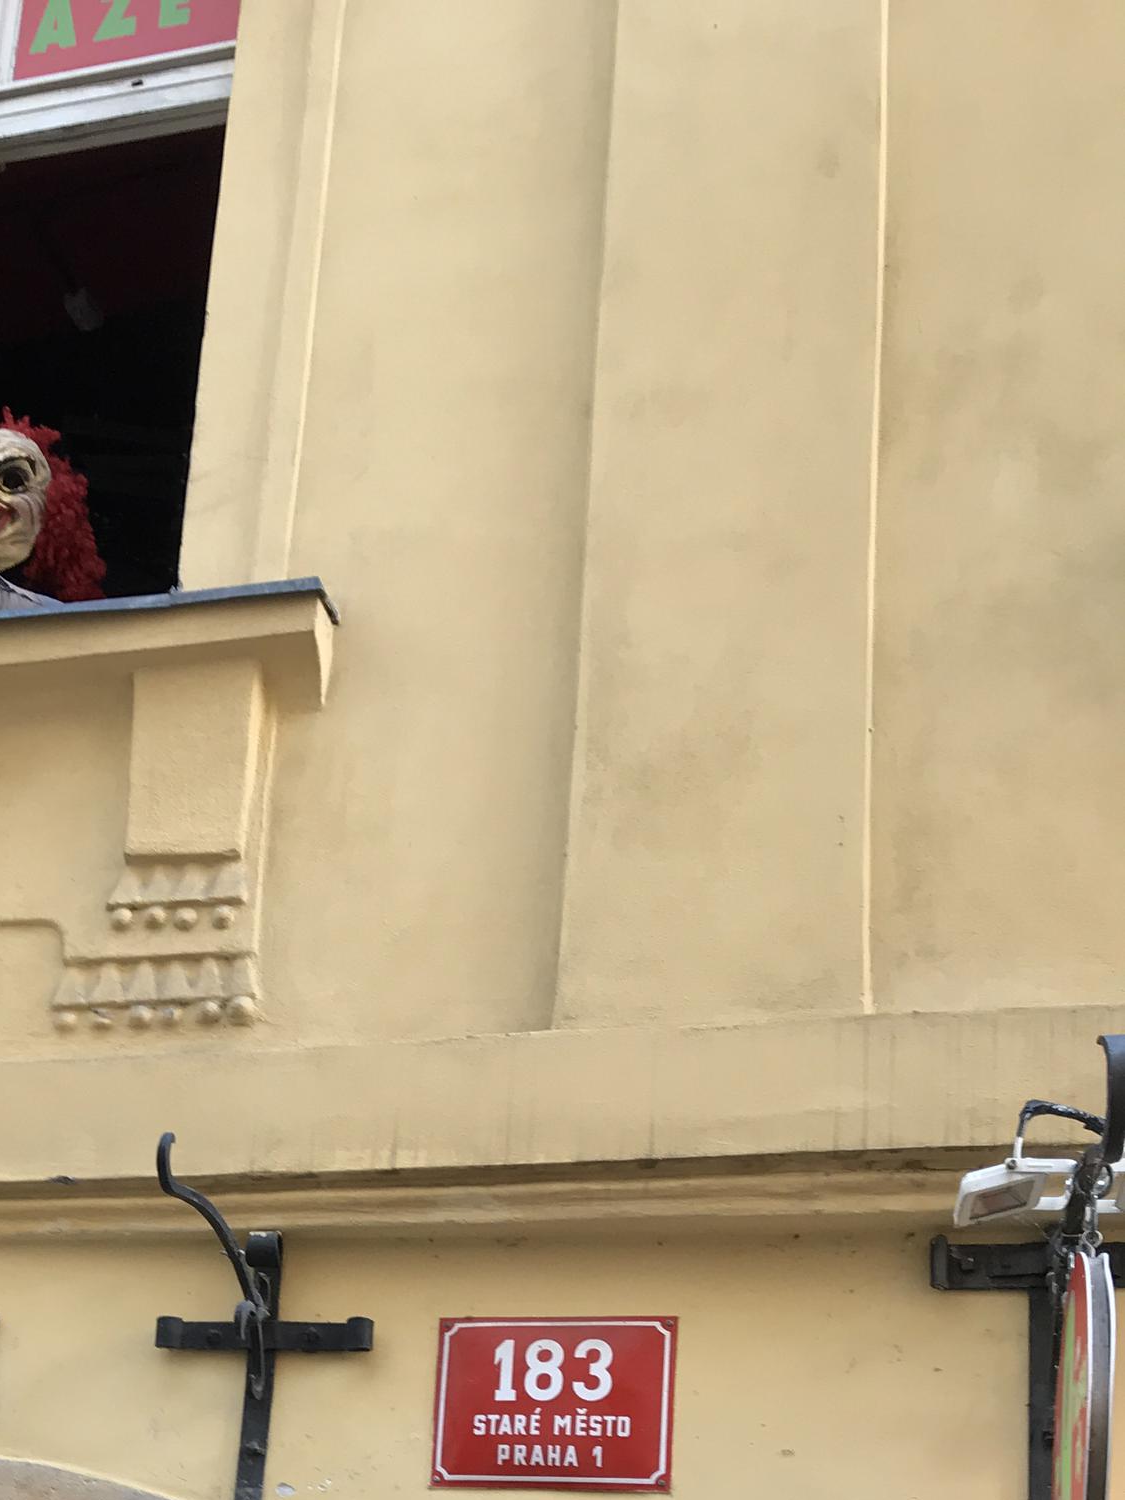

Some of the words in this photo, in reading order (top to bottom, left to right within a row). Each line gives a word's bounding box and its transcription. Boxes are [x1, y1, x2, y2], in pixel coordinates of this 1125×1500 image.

[493, 1338, 614, 1402] 183
[473, 1407, 542, 1436] STARÉ
[553, 1407, 631, 1438] MĚSTO
[497, 1444, 579, 1468] PRAHA
[591, 1446, 604, 1468] 1
